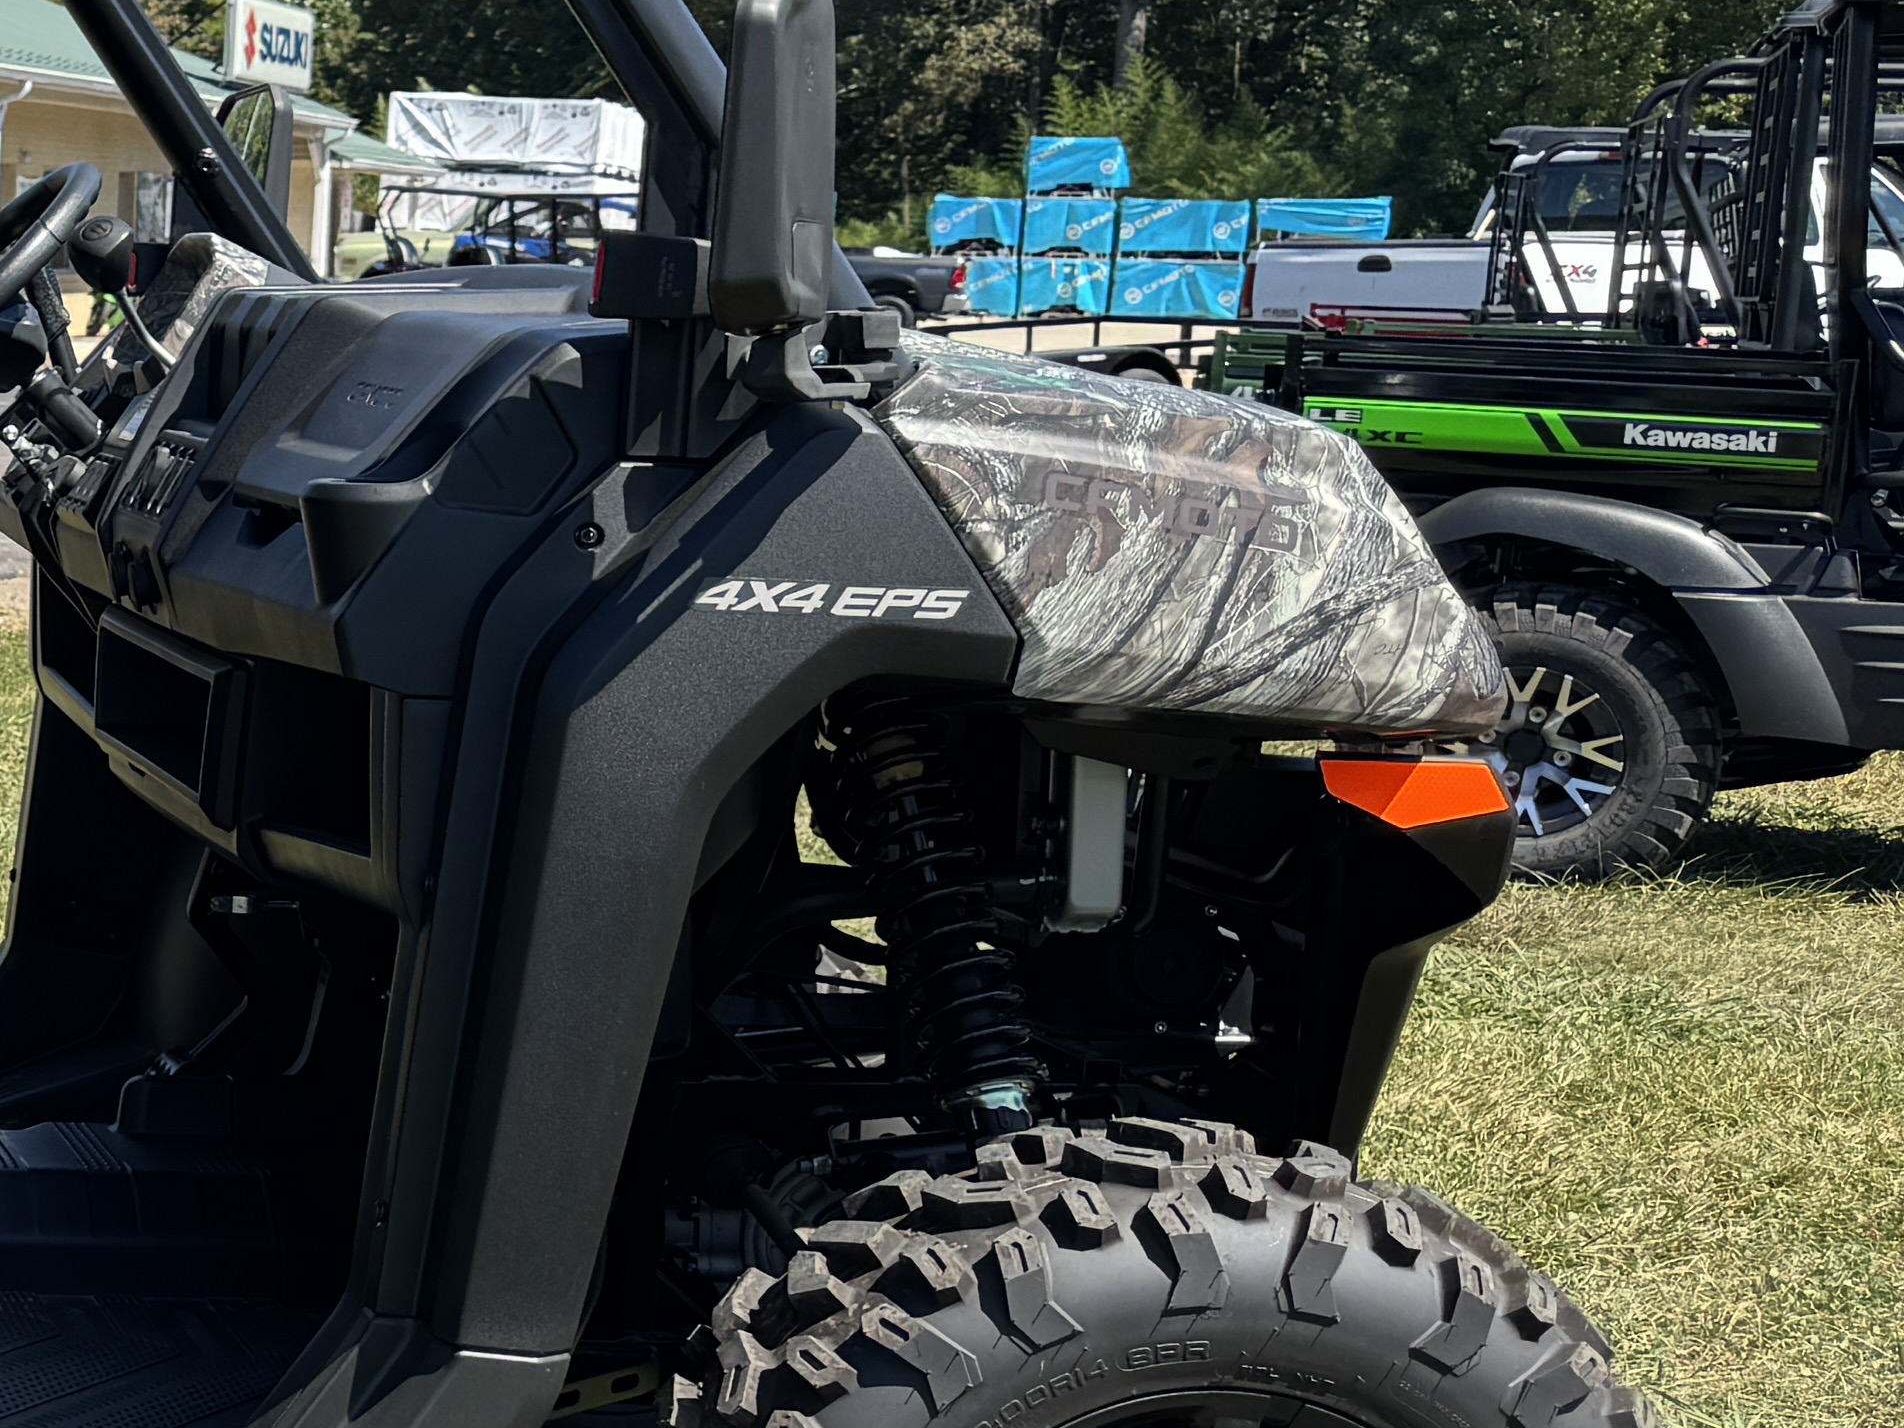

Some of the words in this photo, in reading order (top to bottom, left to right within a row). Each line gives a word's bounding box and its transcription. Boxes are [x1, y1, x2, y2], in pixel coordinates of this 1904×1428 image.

[260, 23, 309, 69] SUZUKI
[1309, 408, 1361, 422] LE
[1623, 422, 1777, 454] Kawasaki
[1045, 471, 1301, 551] CFMOTO
[694, 580, 831, 614] 4X4
[830, 586, 970, 620] EPS
